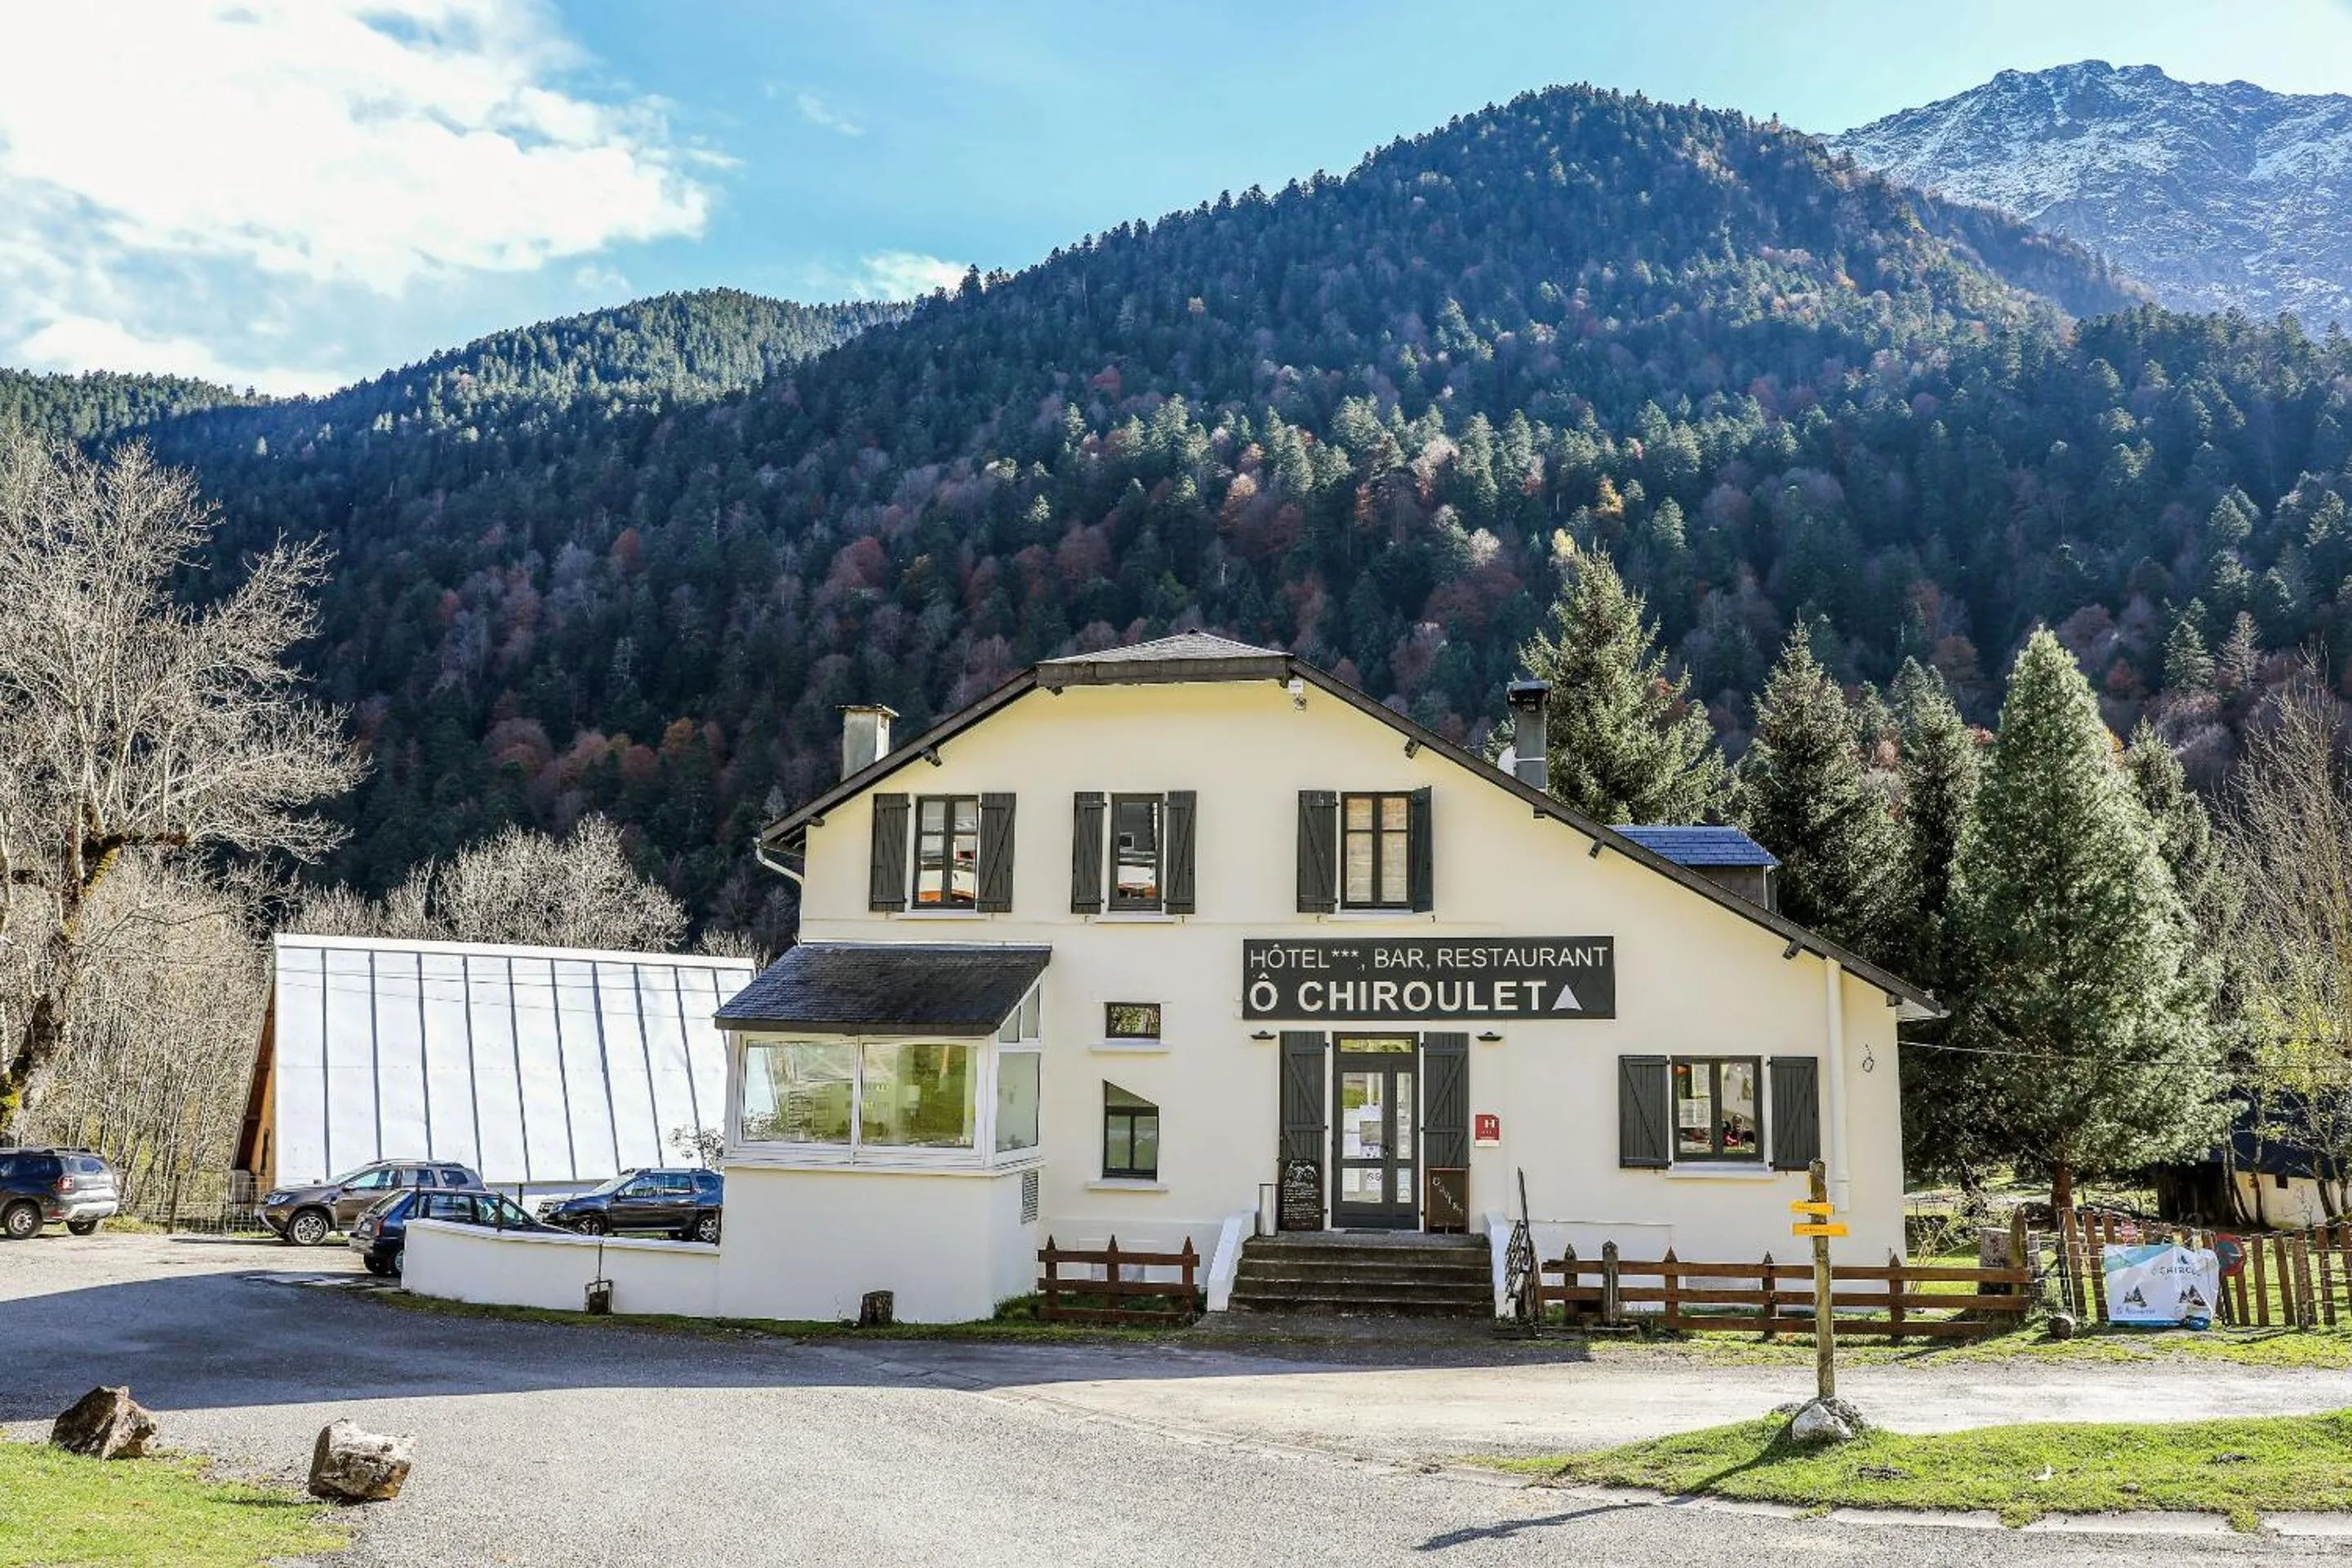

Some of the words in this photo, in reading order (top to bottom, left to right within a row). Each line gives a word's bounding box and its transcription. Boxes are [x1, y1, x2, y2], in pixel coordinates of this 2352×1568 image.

[1374, 947, 1430, 971] BAR,
[1437, 946, 1608, 968] RESTAURANT
[1249, 971, 1278, 1012] Ô
[1297, 980, 1547, 1012] CHIROULET
[1484, 1118, 1496, 1128] H
